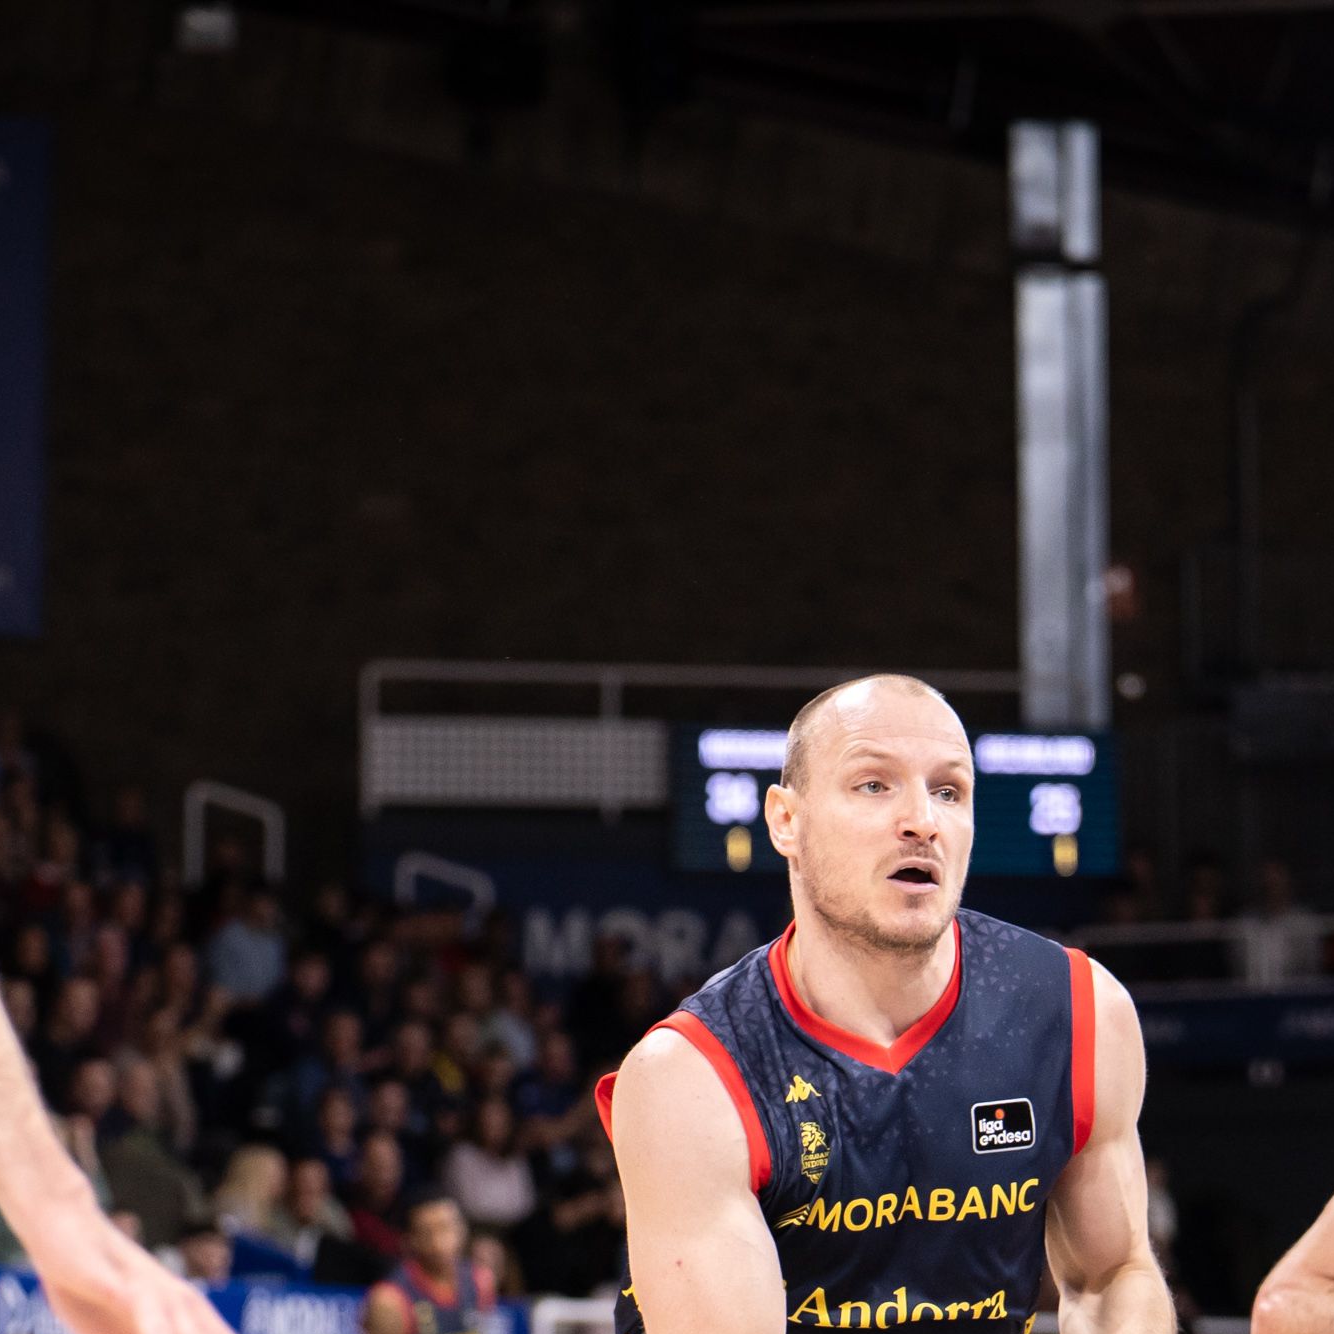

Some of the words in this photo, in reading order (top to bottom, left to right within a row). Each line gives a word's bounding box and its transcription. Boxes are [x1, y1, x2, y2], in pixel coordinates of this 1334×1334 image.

[978, 1118, 1004, 1134] liga
[979, 1130, 1031, 1146] endesa
[806, 1178, 1040, 1232] MORABANC
[787, 1286, 1008, 1330] Andorra
